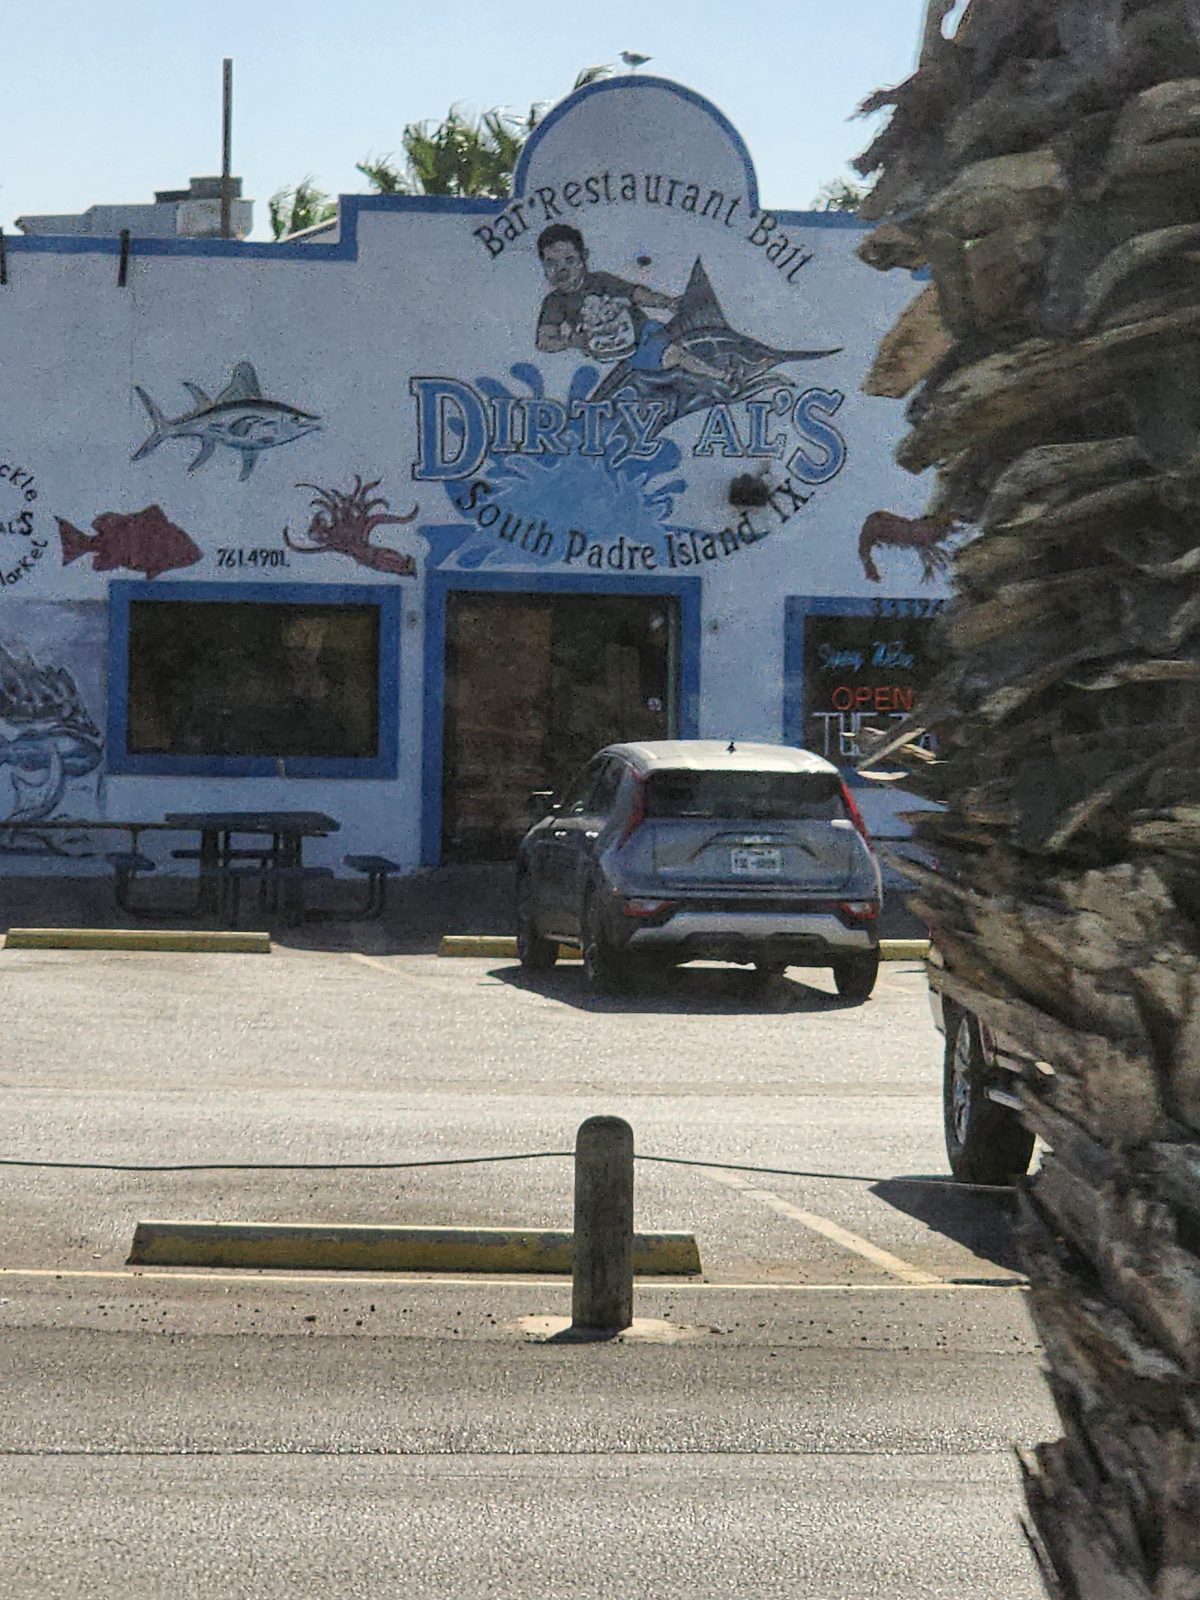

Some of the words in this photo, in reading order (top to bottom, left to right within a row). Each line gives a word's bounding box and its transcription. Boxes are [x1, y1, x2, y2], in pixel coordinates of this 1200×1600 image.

[473, 203, 530, 261] Bar
[534, 168, 742, 230] Restaurant
[409, 376, 669, 482] DIRTY
[692, 386, 848, 486] AL'S
[0, 539, 48, 587] arket
[456, 480, 556, 558] South
[563, 530, 657, 571] Padre
[663, 510, 761, 570] Island
[831, 686, 914, 711] OPEN
